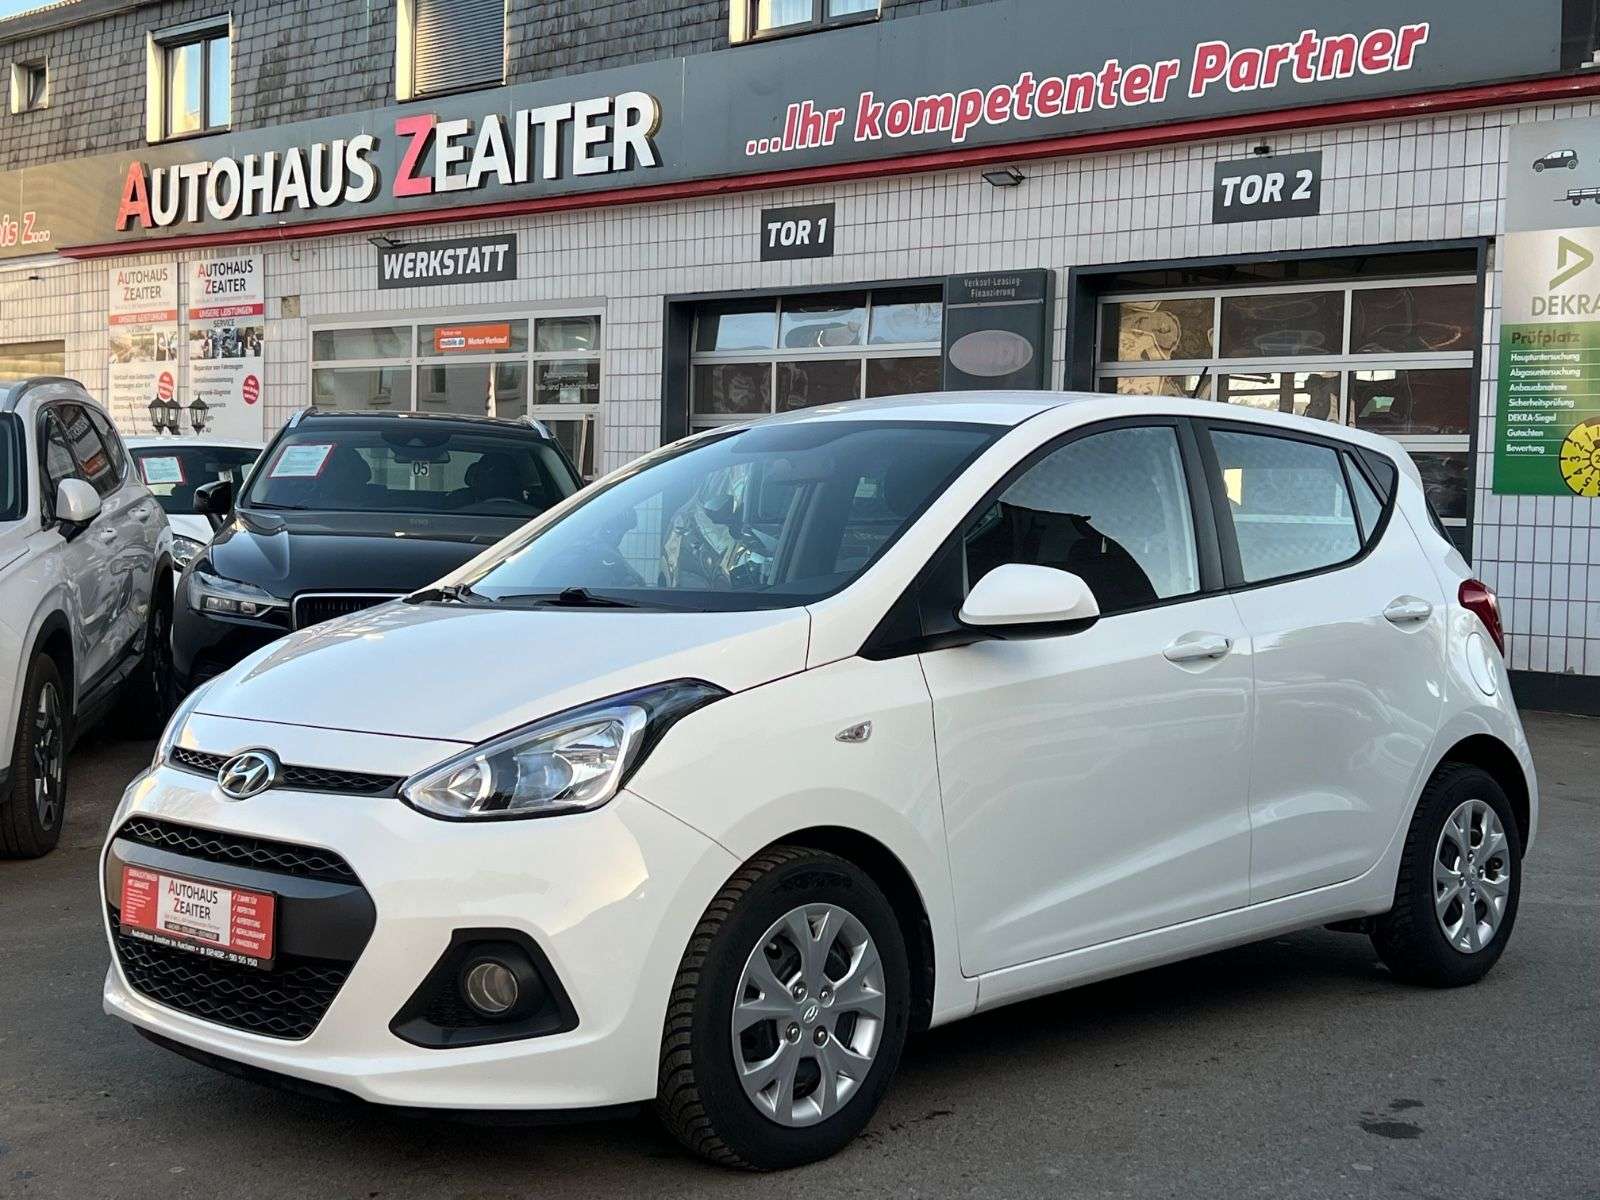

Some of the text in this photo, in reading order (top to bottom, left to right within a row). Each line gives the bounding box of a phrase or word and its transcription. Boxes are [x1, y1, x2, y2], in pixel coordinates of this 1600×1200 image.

[854, 58, 1180, 143] kompetenter
[1188, 22, 1429, 98] Partner
[115, 91, 659, 231] AUTOHAUS ZEAITER
[1221, 169, 1313, 207] TOR 2
[0, 214, 18, 247] is
[767, 217, 827, 248] TOR 1
[198, 259, 253, 278] AUTOHAUS
[383, 243, 509, 280] WERKSTATT
[117, 268, 168, 286] AUTOHAUS
[205, 277, 246, 294] ZEAITER
[123, 285, 162, 301] ZEAITER
[213, 319, 235, 328] SERVICE
[1511, 330, 1580, 347] Prüfplatz
[1510, 352, 1580, 363] Hauptuntersuchung
[1510, 367, 1581, 378] Abgasuntersuchung
[1509, 382, 1567, 391] Anbauabnahme
[1508, 397, 1575, 409] Sicherheitsprüfung
[1507, 412, 1556, 424] DEKRA-Siegel
[1507, 428, 1544, 437] Gutachten
[1506, 443, 1545, 454] Bewertung
[413, 462, 428, 475] 05
[1583, 477, 1593, 487] 5
[168, 879, 218, 905] AUTOHAUS
[173, 897, 211, 920] ZEAITER
